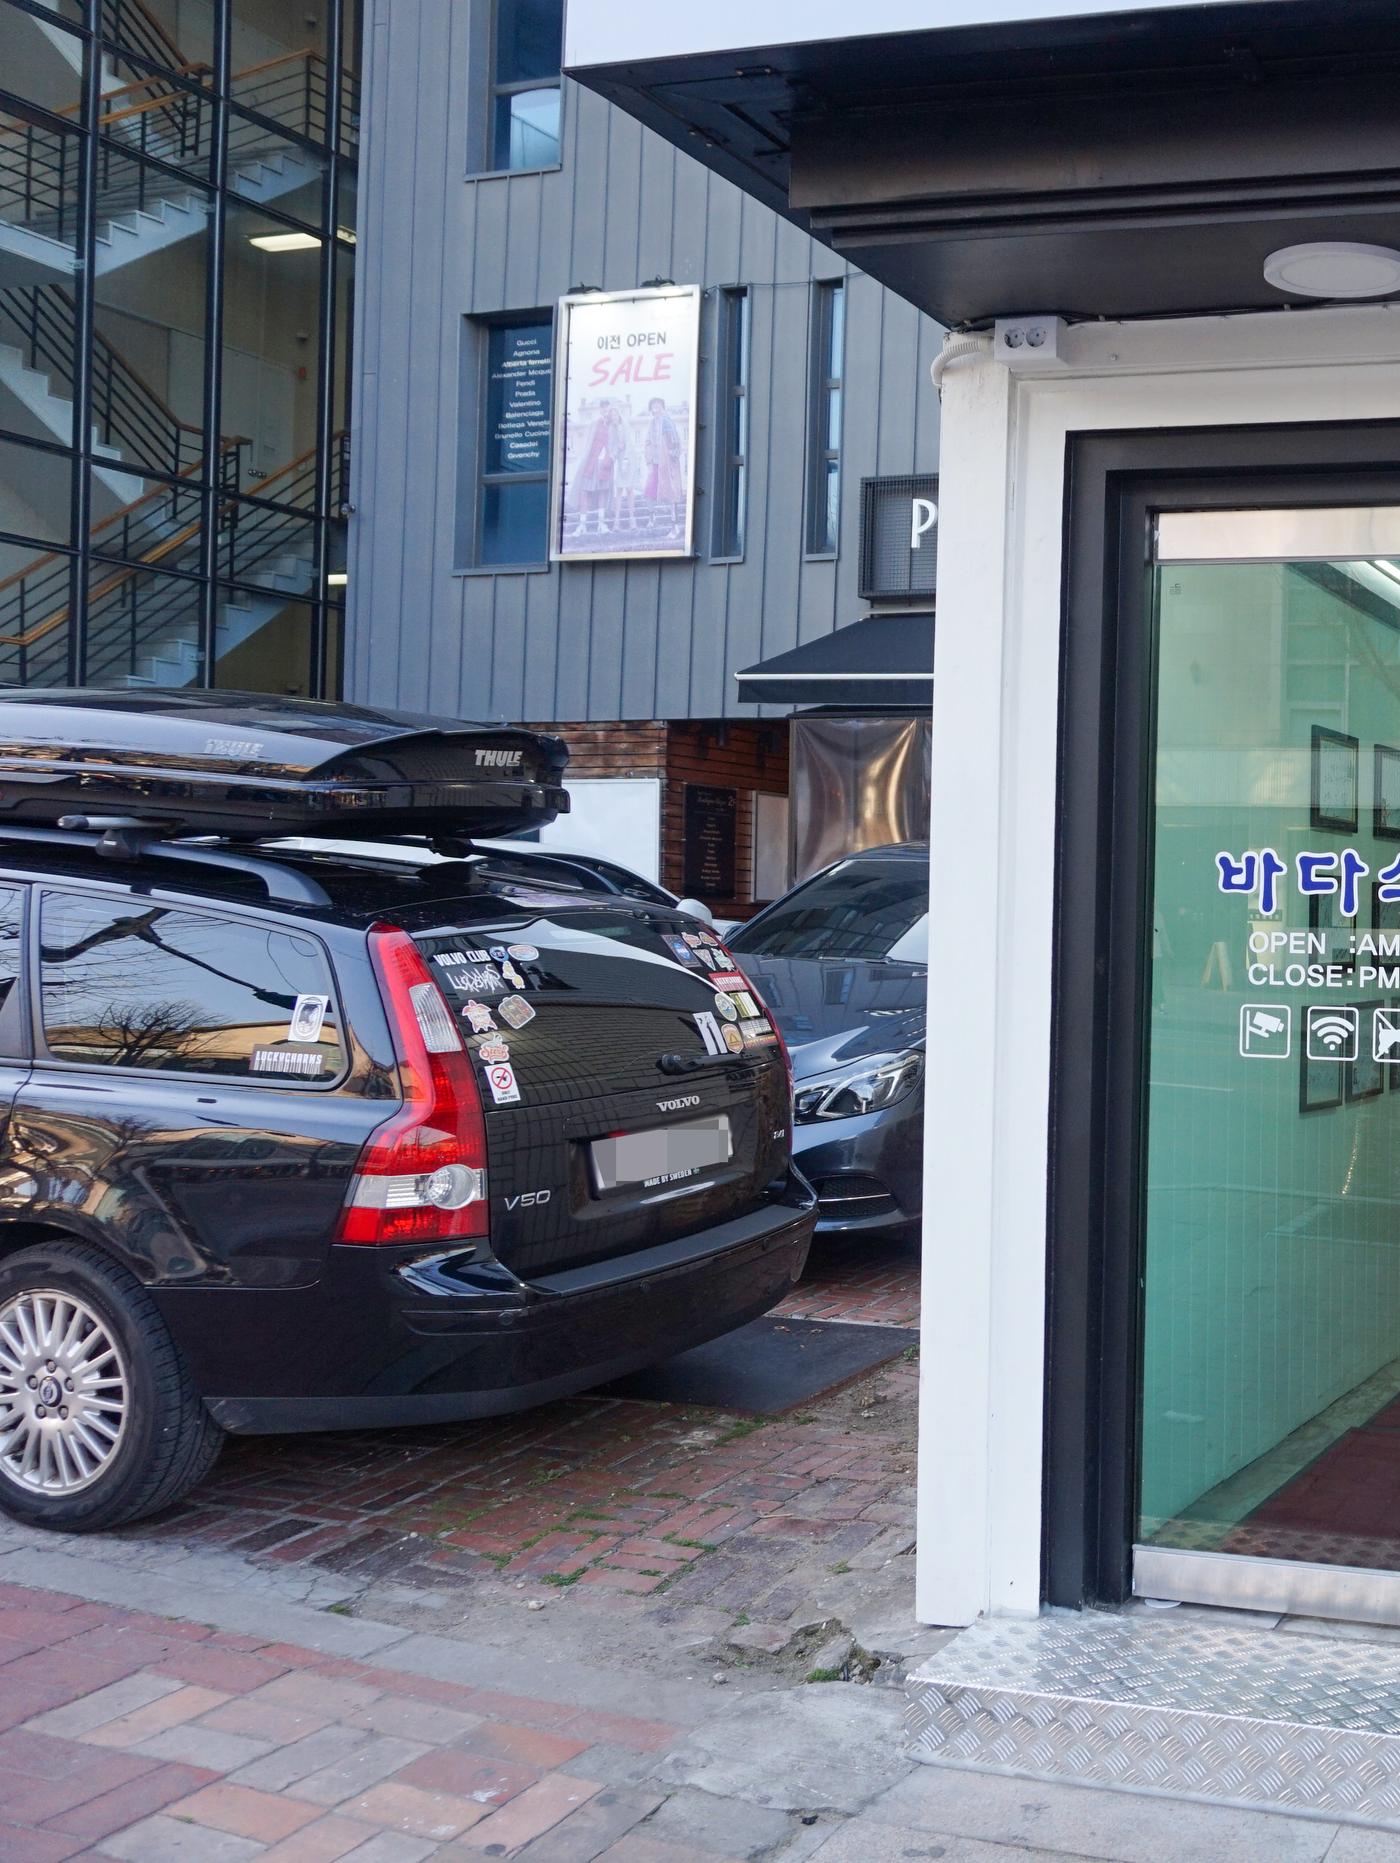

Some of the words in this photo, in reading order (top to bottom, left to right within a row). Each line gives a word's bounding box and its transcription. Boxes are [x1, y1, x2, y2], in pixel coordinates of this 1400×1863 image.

[597, 335, 620, 349] 이전
[627, 332, 667, 347] OPEN
[588, 353, 674, 387] SALE
[509, 400, 541, 408] Valentino
[505, 411, 544, 419] Balenciaga
[507, 451, 540, 459] Givenchy
[475, 749, 524, 767] THULE
[1249, 932, 1326, 954] OPEN
[433, 952, 467, 967] VOLVO
[466, 950, 491, 963] CLUB
[656, 1095, 700, 1112] VOLVO
[504, 1190, 551, 1212] V50
